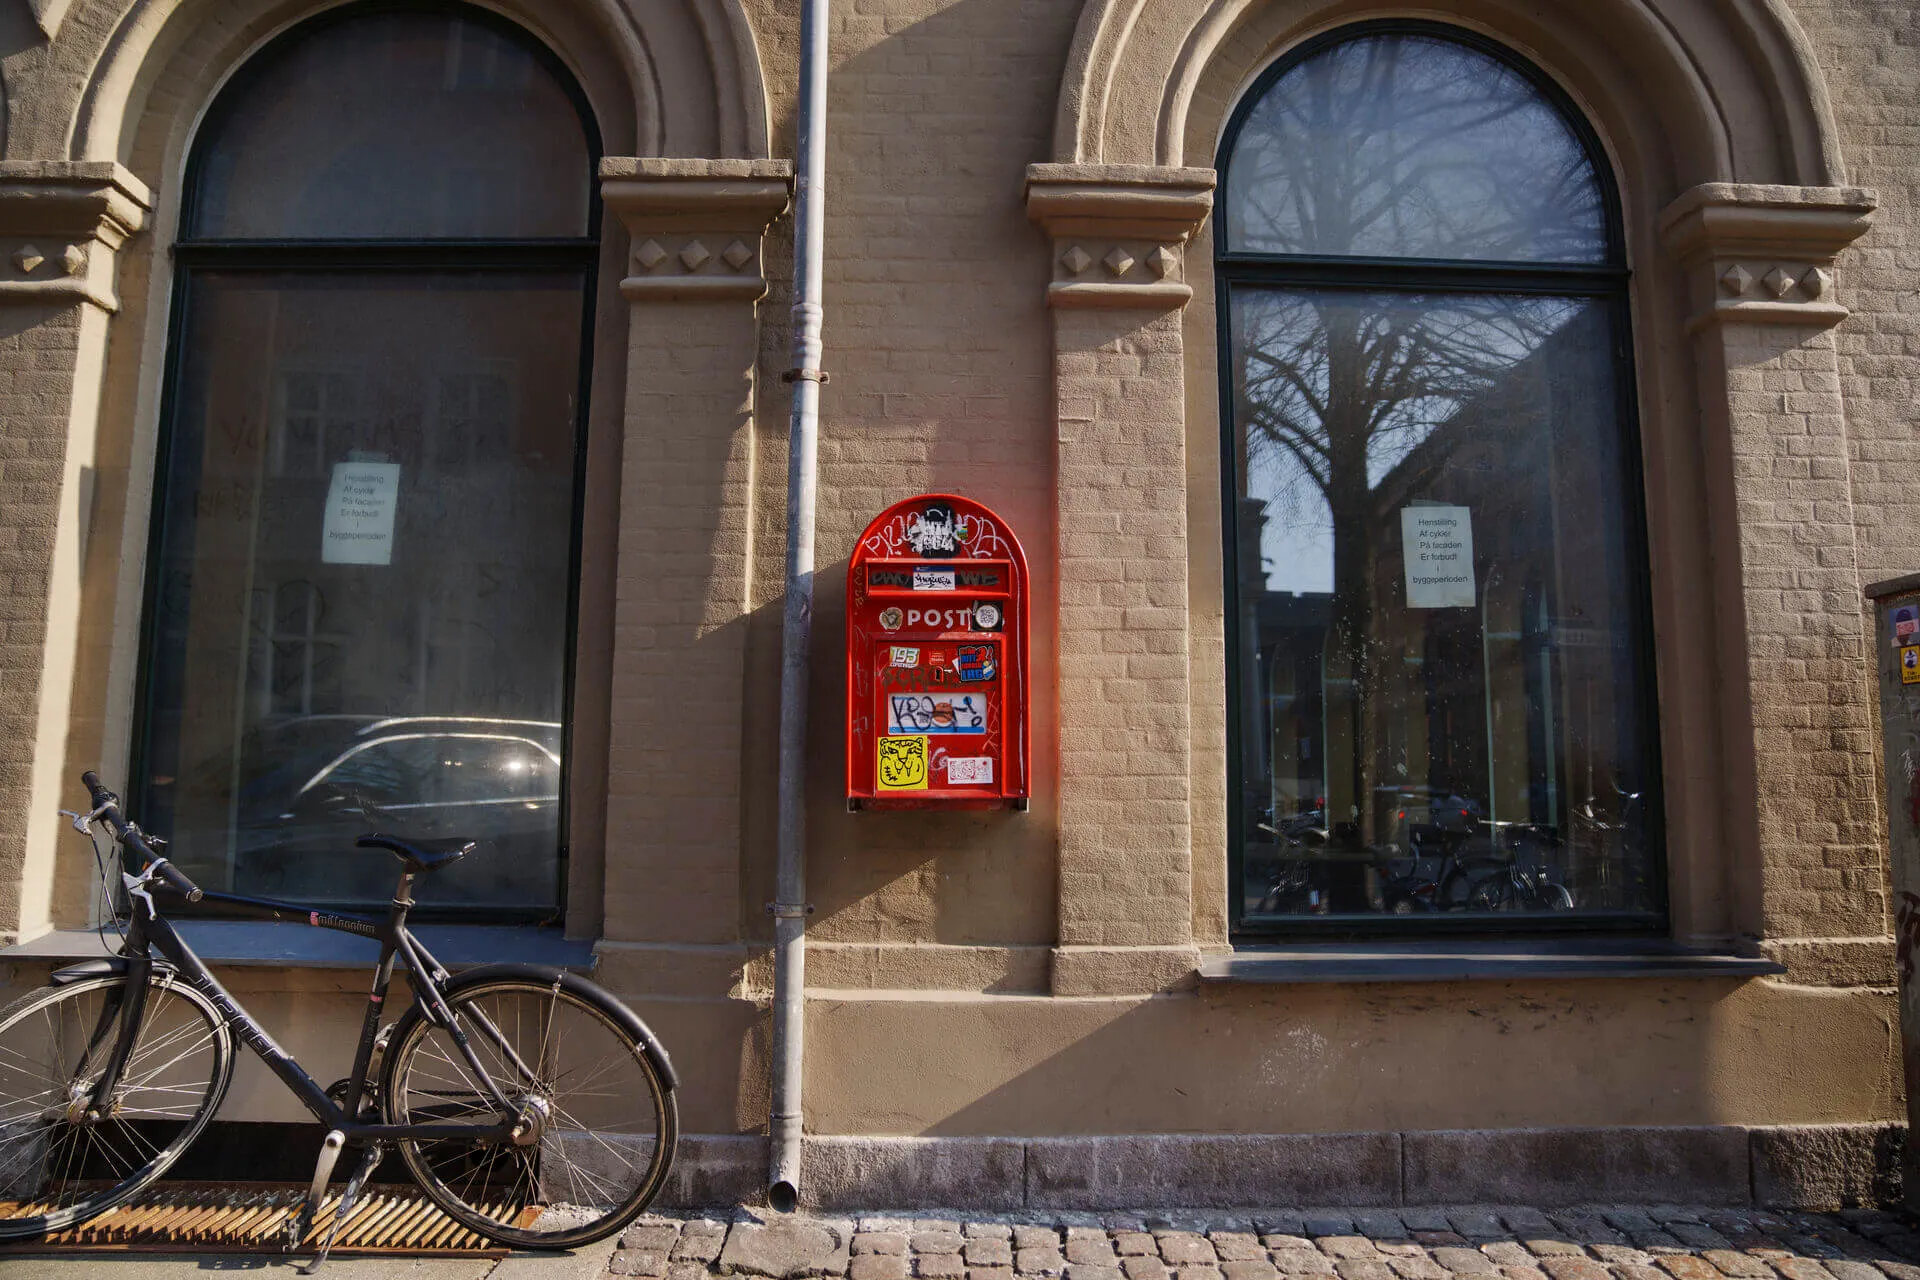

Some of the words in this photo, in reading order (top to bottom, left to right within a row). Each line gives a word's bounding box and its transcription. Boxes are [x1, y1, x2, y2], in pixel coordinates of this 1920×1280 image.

[1420, 553, 1430, 561] Er
[907, 609, 970, 629] POST
[889, 646, 919, 664] 193
